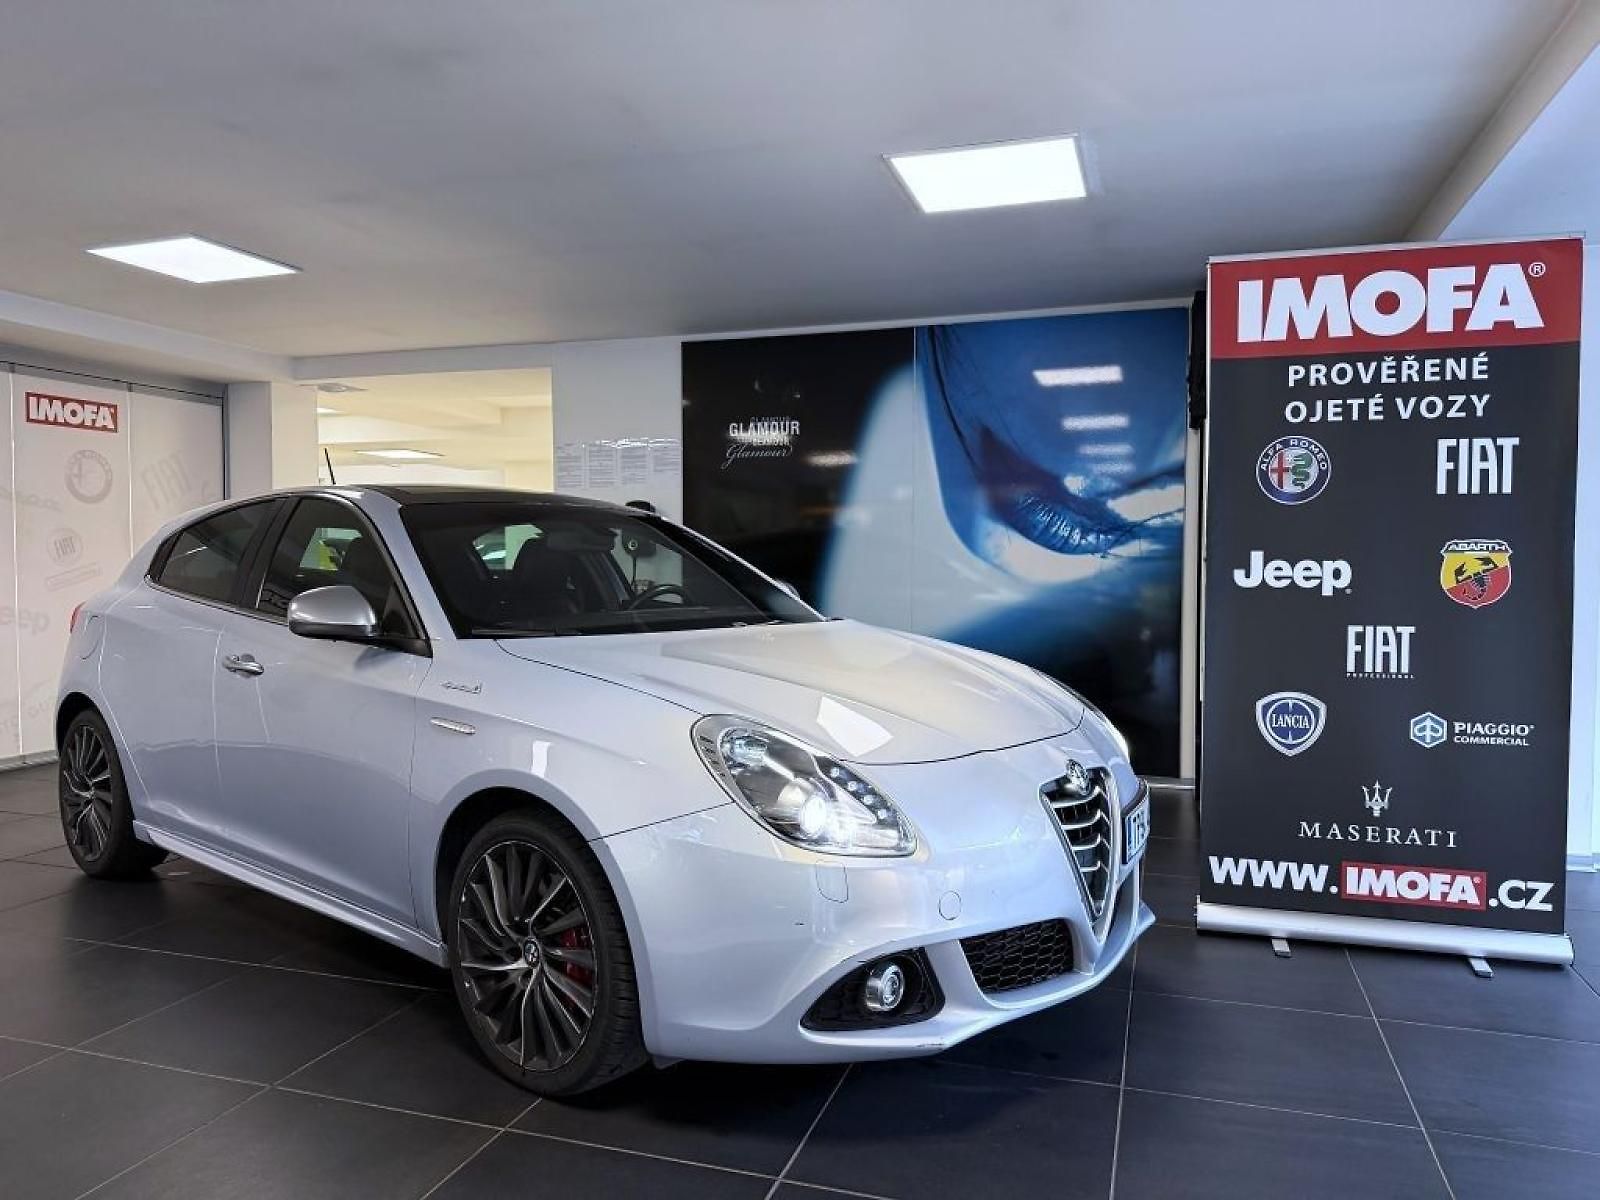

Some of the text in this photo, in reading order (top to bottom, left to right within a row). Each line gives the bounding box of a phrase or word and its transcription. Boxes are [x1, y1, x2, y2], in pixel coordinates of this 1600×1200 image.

[1288, 352, 1489, 387] PROVĚŘENÉ
[29, 396, 115, 429] IMOFA
[1285, 393, 1490, 423] OJETÉ VOZY
[729, 420, 800, 436] GLAMOUR
[1290, 439, 1327, 470] ROMEO
[1436, 437, 1519, 494] FIAT
[1448, 543, 1506, 551] ABARTH
[1233, 550, 1352, 596] Jeep
[1346, 624, 1416, 673] FIAT
[1272, 713, 1310, 729] LANCIA
[1453, 721, 1529, 736] PIAGGIO
[1454, 736, 1530, 746] COMMERCIAL
[1298, 821, 1457, 848] MASERATI
